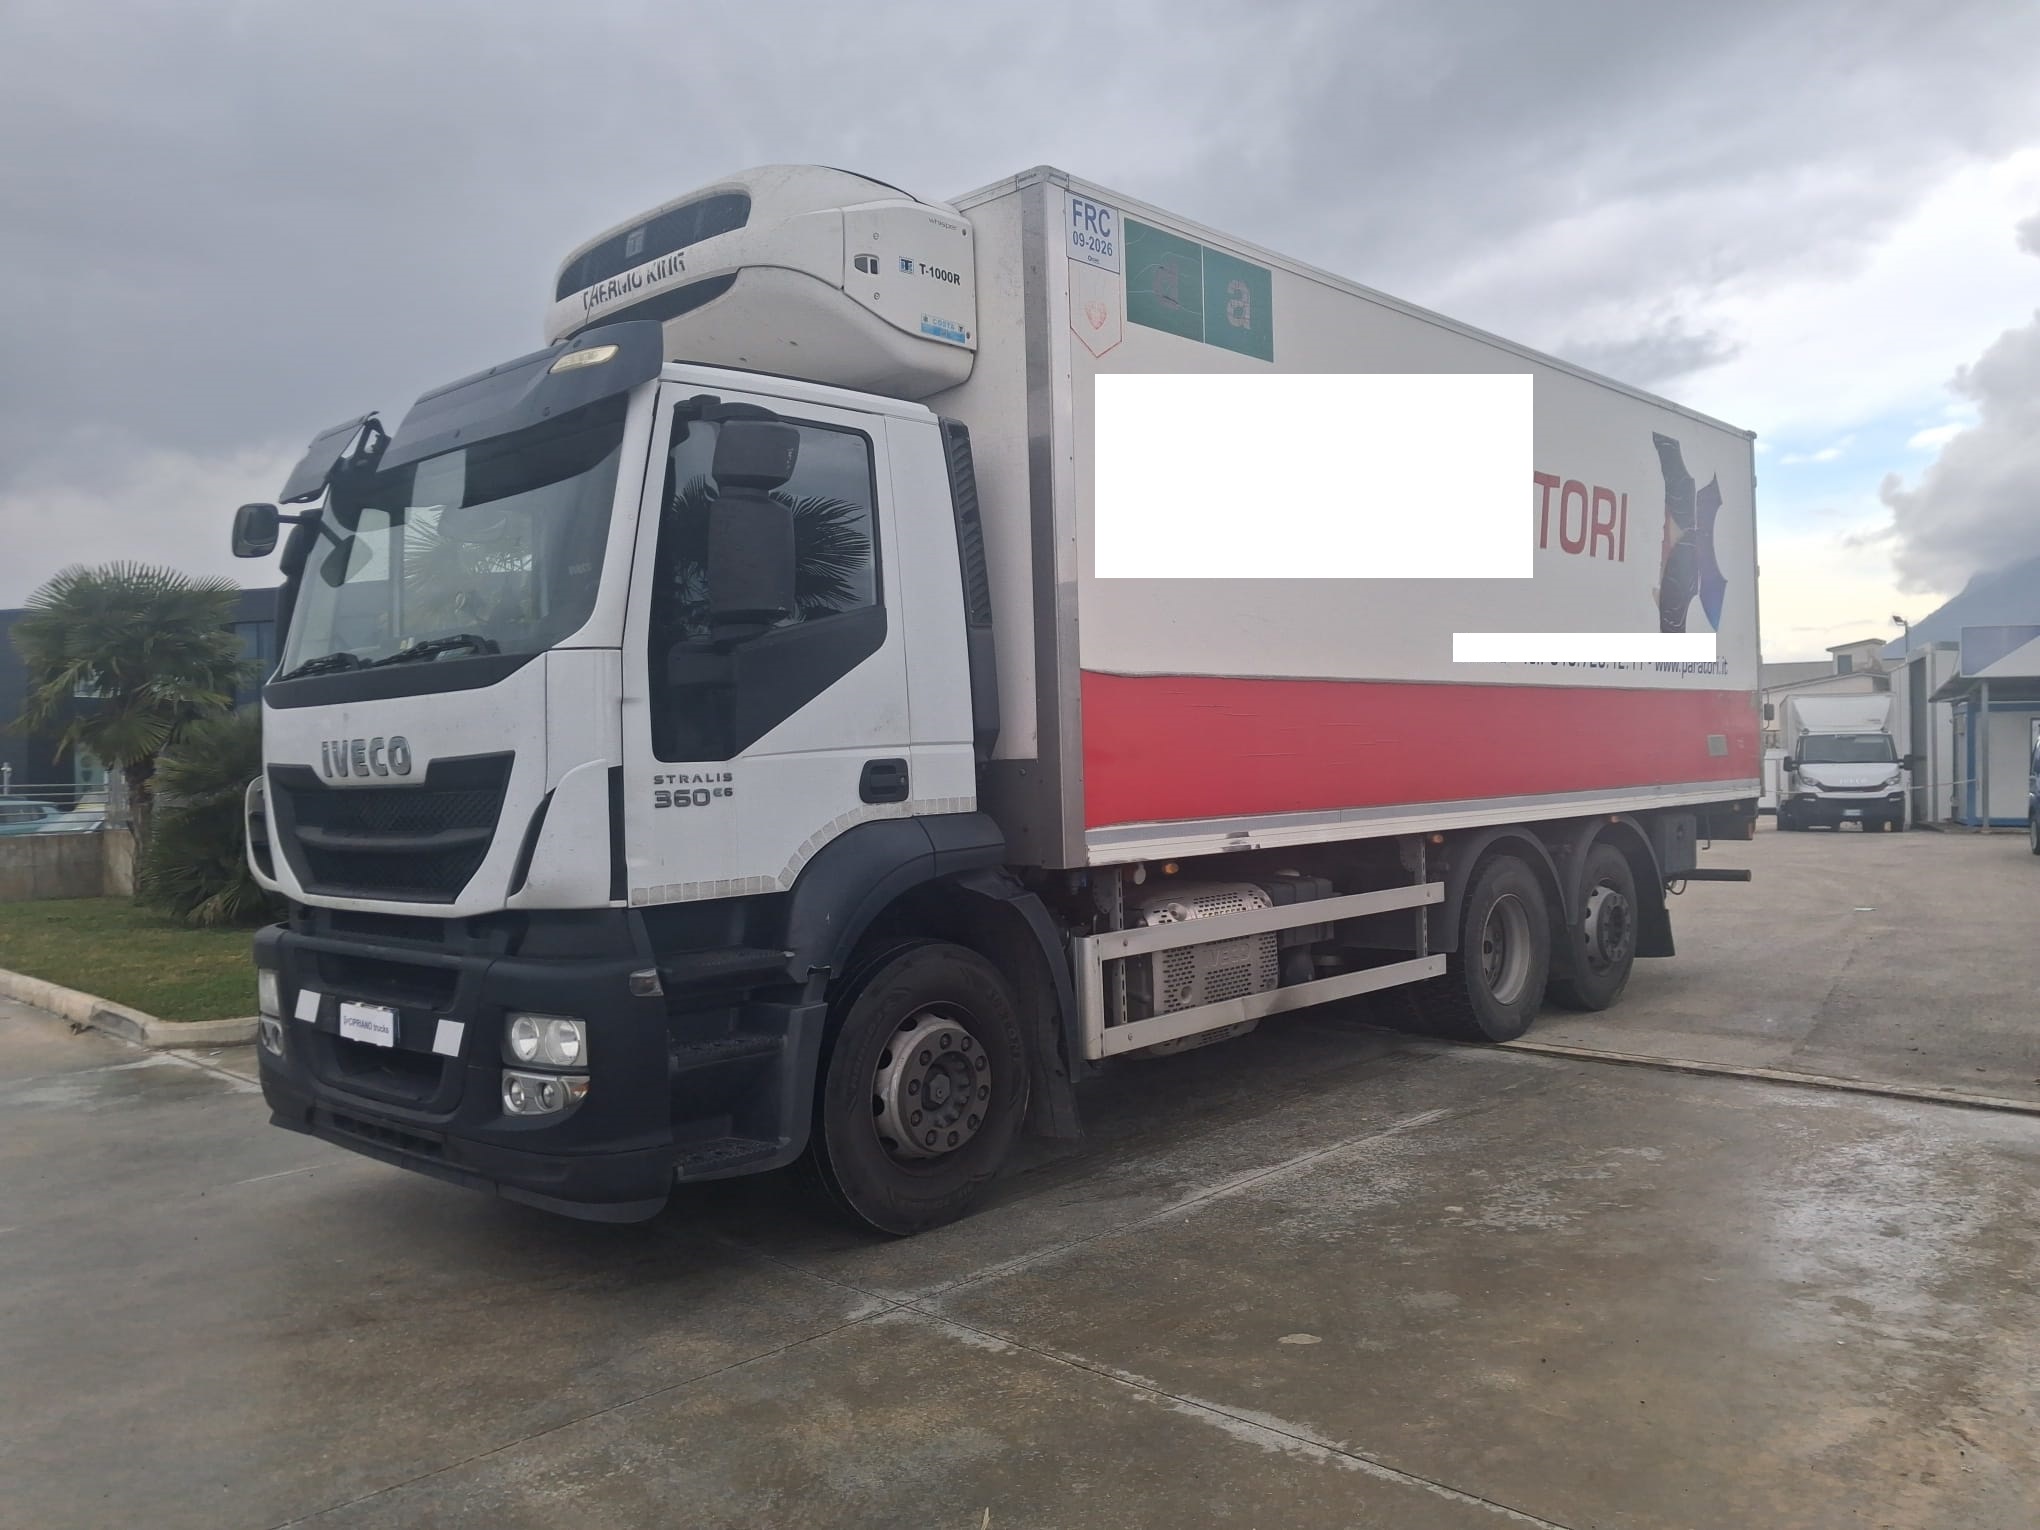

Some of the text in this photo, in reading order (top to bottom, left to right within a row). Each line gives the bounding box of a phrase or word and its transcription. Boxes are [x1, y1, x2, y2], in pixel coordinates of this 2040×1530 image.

[1072, 198, 1111, 238] FRC
[1072, 230, 1113, 257] 09-2026
[919, 262, 961, 286] T-1000R
[1533, 469, 1628, 563] TORI
[321, 735, 412, 778] IVECO
[653, 772, 733, 784] STRALIS
[654, 788, 711, 809] 360
